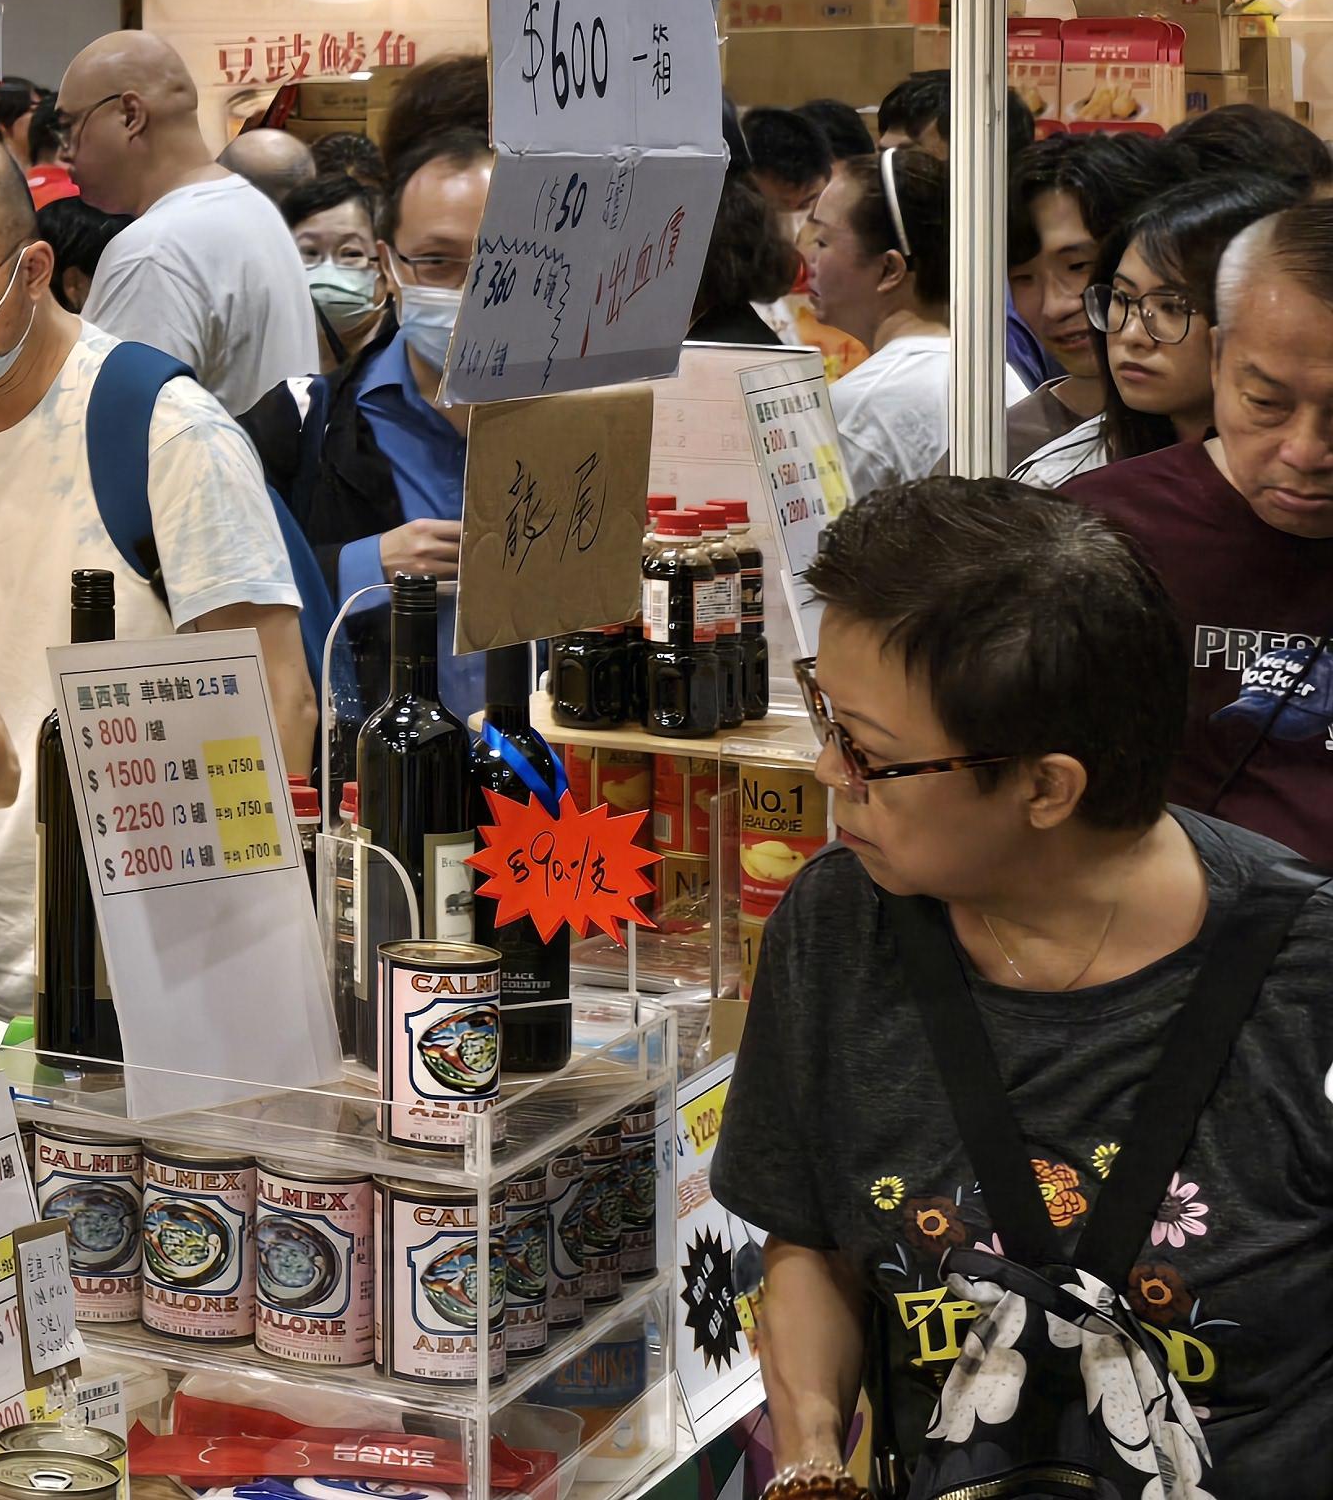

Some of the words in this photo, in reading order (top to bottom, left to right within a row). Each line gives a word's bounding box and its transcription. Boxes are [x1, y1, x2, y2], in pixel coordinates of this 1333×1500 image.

[743, 778, 803, 814] No.1
[411, 974, 499, 995] CALM
[40, 1145, 142, 1172] CALME
